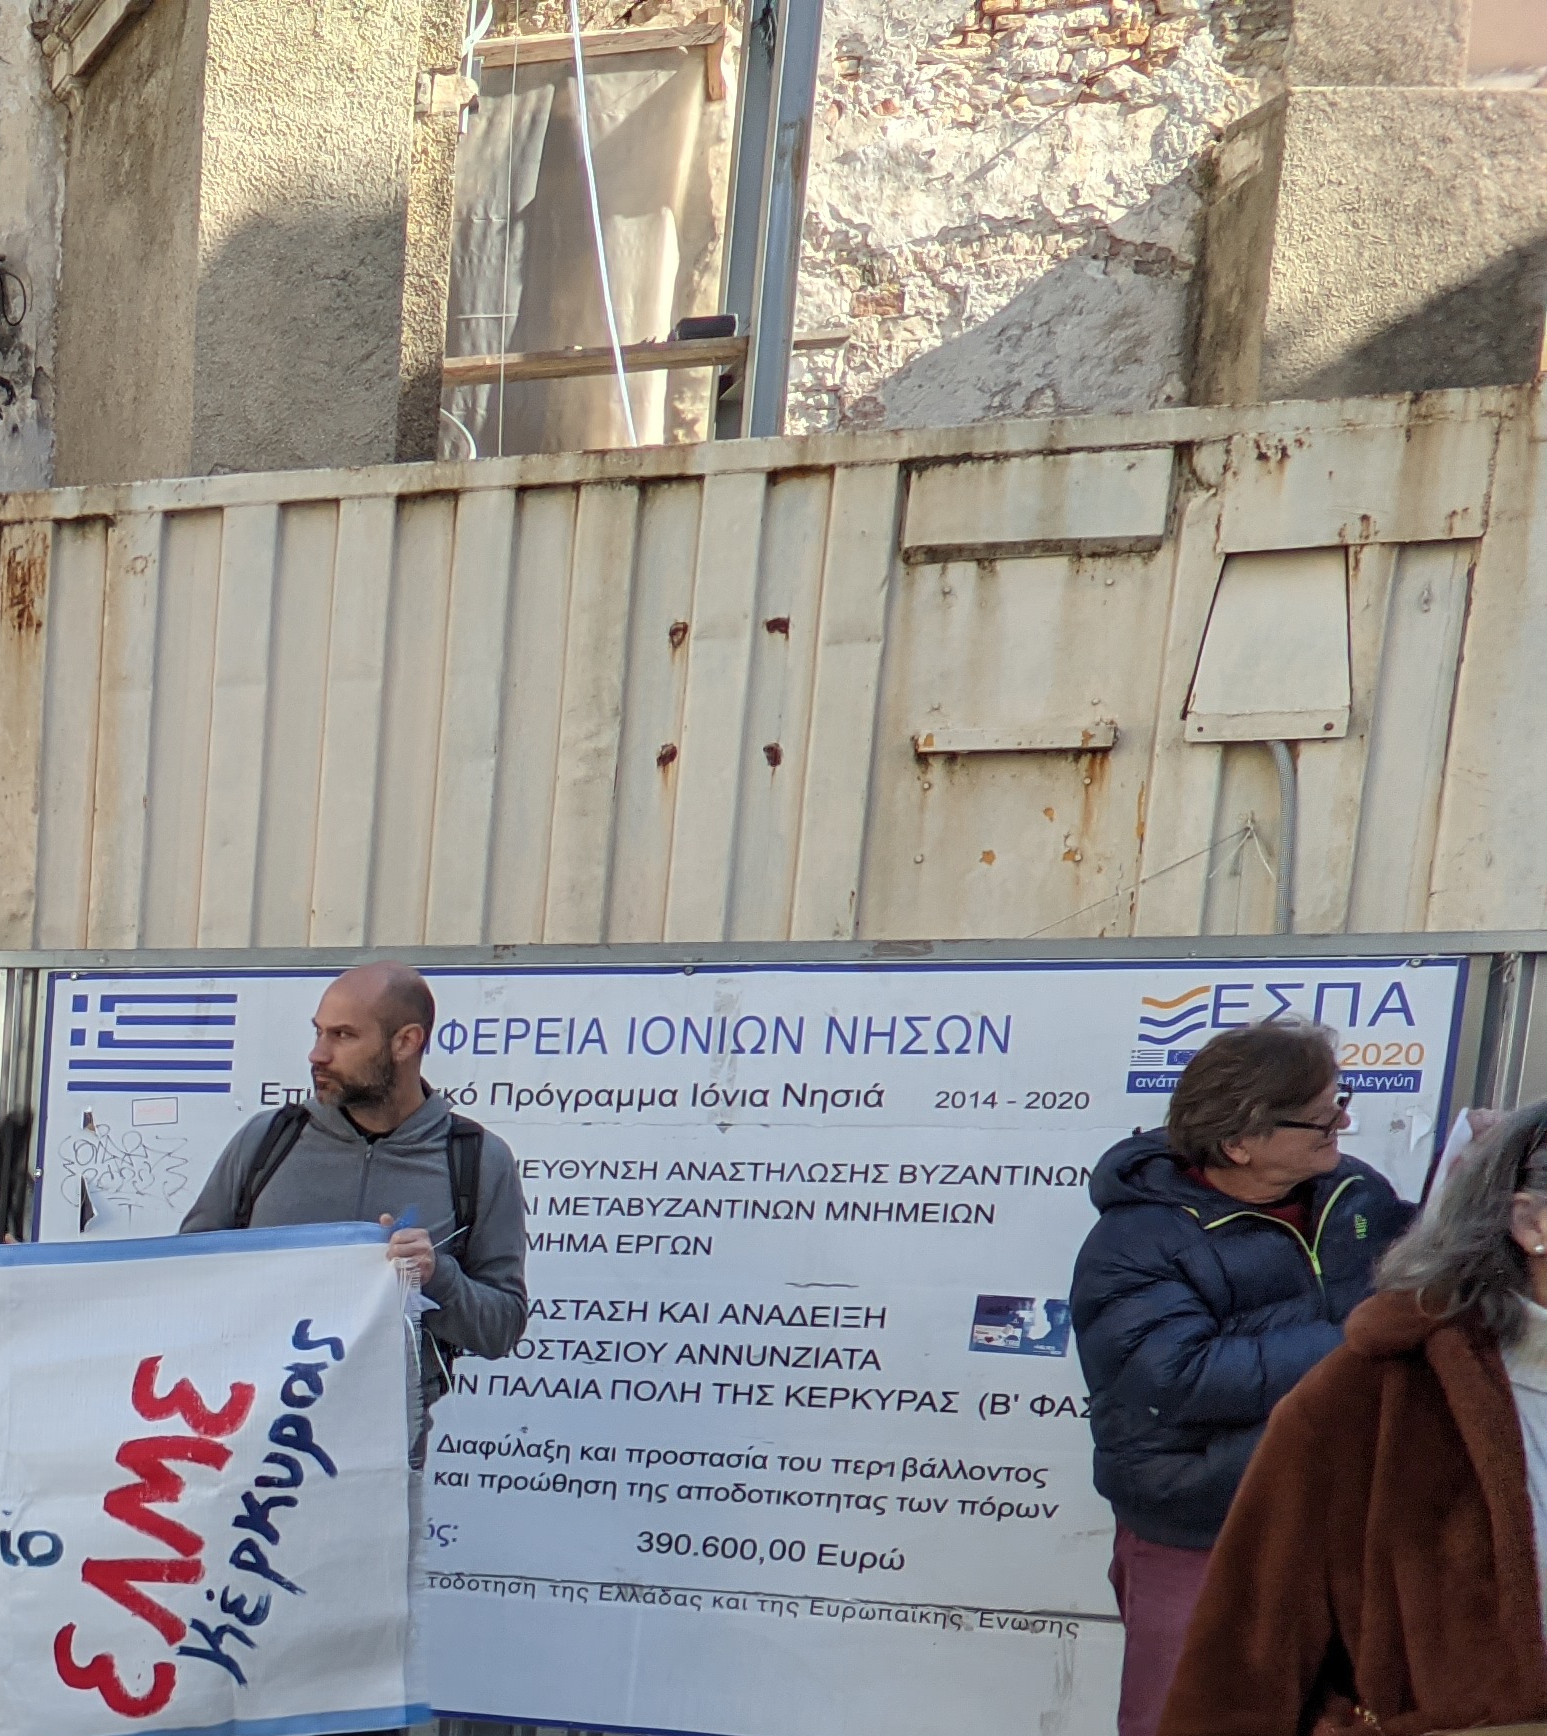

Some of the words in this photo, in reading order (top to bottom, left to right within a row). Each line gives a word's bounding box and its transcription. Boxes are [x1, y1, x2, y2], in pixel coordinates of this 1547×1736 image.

[1210, 981, 1417, 1029] ΕΣΠΑ
[426, 1016, 609, 1056] ΦΕΡΕΙΑ
[626, 1015, 805, 1056] ΙΟΝΙΩΝ
[824, 1014, 1013, 1056] ΝΗΣΩΝ
[490, 1080, 678, 1113] Πρόγραμμα
[691, 1080, 770, 1109] Ιόνια
[781, 1081, 885, 1114] Νησιά
[934, 1090, 999, 1110] 2014
[1024, 1090, 1091, 1110] 2020
[1135, 1072, 1183, 1089] ανάπ
[665, 1161, 890, 1184] ΑΝΑΣΤΗΛΩΣΗΣ
[898, 1164, 1092, 1187] ΒΥΖΑΝΤΙΝΩΝ
[548, 1197, 815, 1220] ΜΕΤΑΒΥΖΑΝΤΙΝΩΝ
[825, 1201, 995, 1225] ΜΝΗΜΕΙΩΝ
[525, 1232, 609, 1254] ΜΗΜΑ
[615, 1234, 713, 1256] ΕΡΓΩΝ
[527, 1299, 649, 1322] ΑΣΤΑΣΗ
[659, 1302, 710, 1324] ΚΑΙ
[718, 1303, 887, 1329] ΑΝΑΔΕΙΞΗ
[512, 1339, 668, 1363] ΟΣΤΑΣΙΟΥ
[488, 1375, 603, 1400] ΠΑΛΑΙΑ
[610, 1379, 702, 1404] ΠΟΛΗ
[712, 1384, 775, 1406] ΤΗΣ
[785, 1385, 960, 1414] ΚΕΡΚΥΡΑΣ
[1029, 1394, 1092, 1419] ΦΑΣ
[436, 1433, 571, 1464] Διαφύλαξη
[580, 1444, 617, 1462] και
[625, 1446, 768, 1475] προστασία
[777, 1455, 822, 1472] του
[176, 1316, 347, 1688] Κέρκυρας
[433, 1470, 470, 1487] και
[477, 1470, 617, 1500] προώθηση
[626, 1480, 669, 1503] της
[896, 1496, 949, 1514] των
[957, 1495, 1060, 1522] πόρων
[636, 1530, 806, 1566] 390.600,00
[816, 1543, 906, 1574] Ευρώ
[548, 1583, 590, 1602] της
[598, 1584, 703, 1611] Ελλάδας
[712, 1593, 748, 1610] και
[757, 1598, 800, 1619] της
